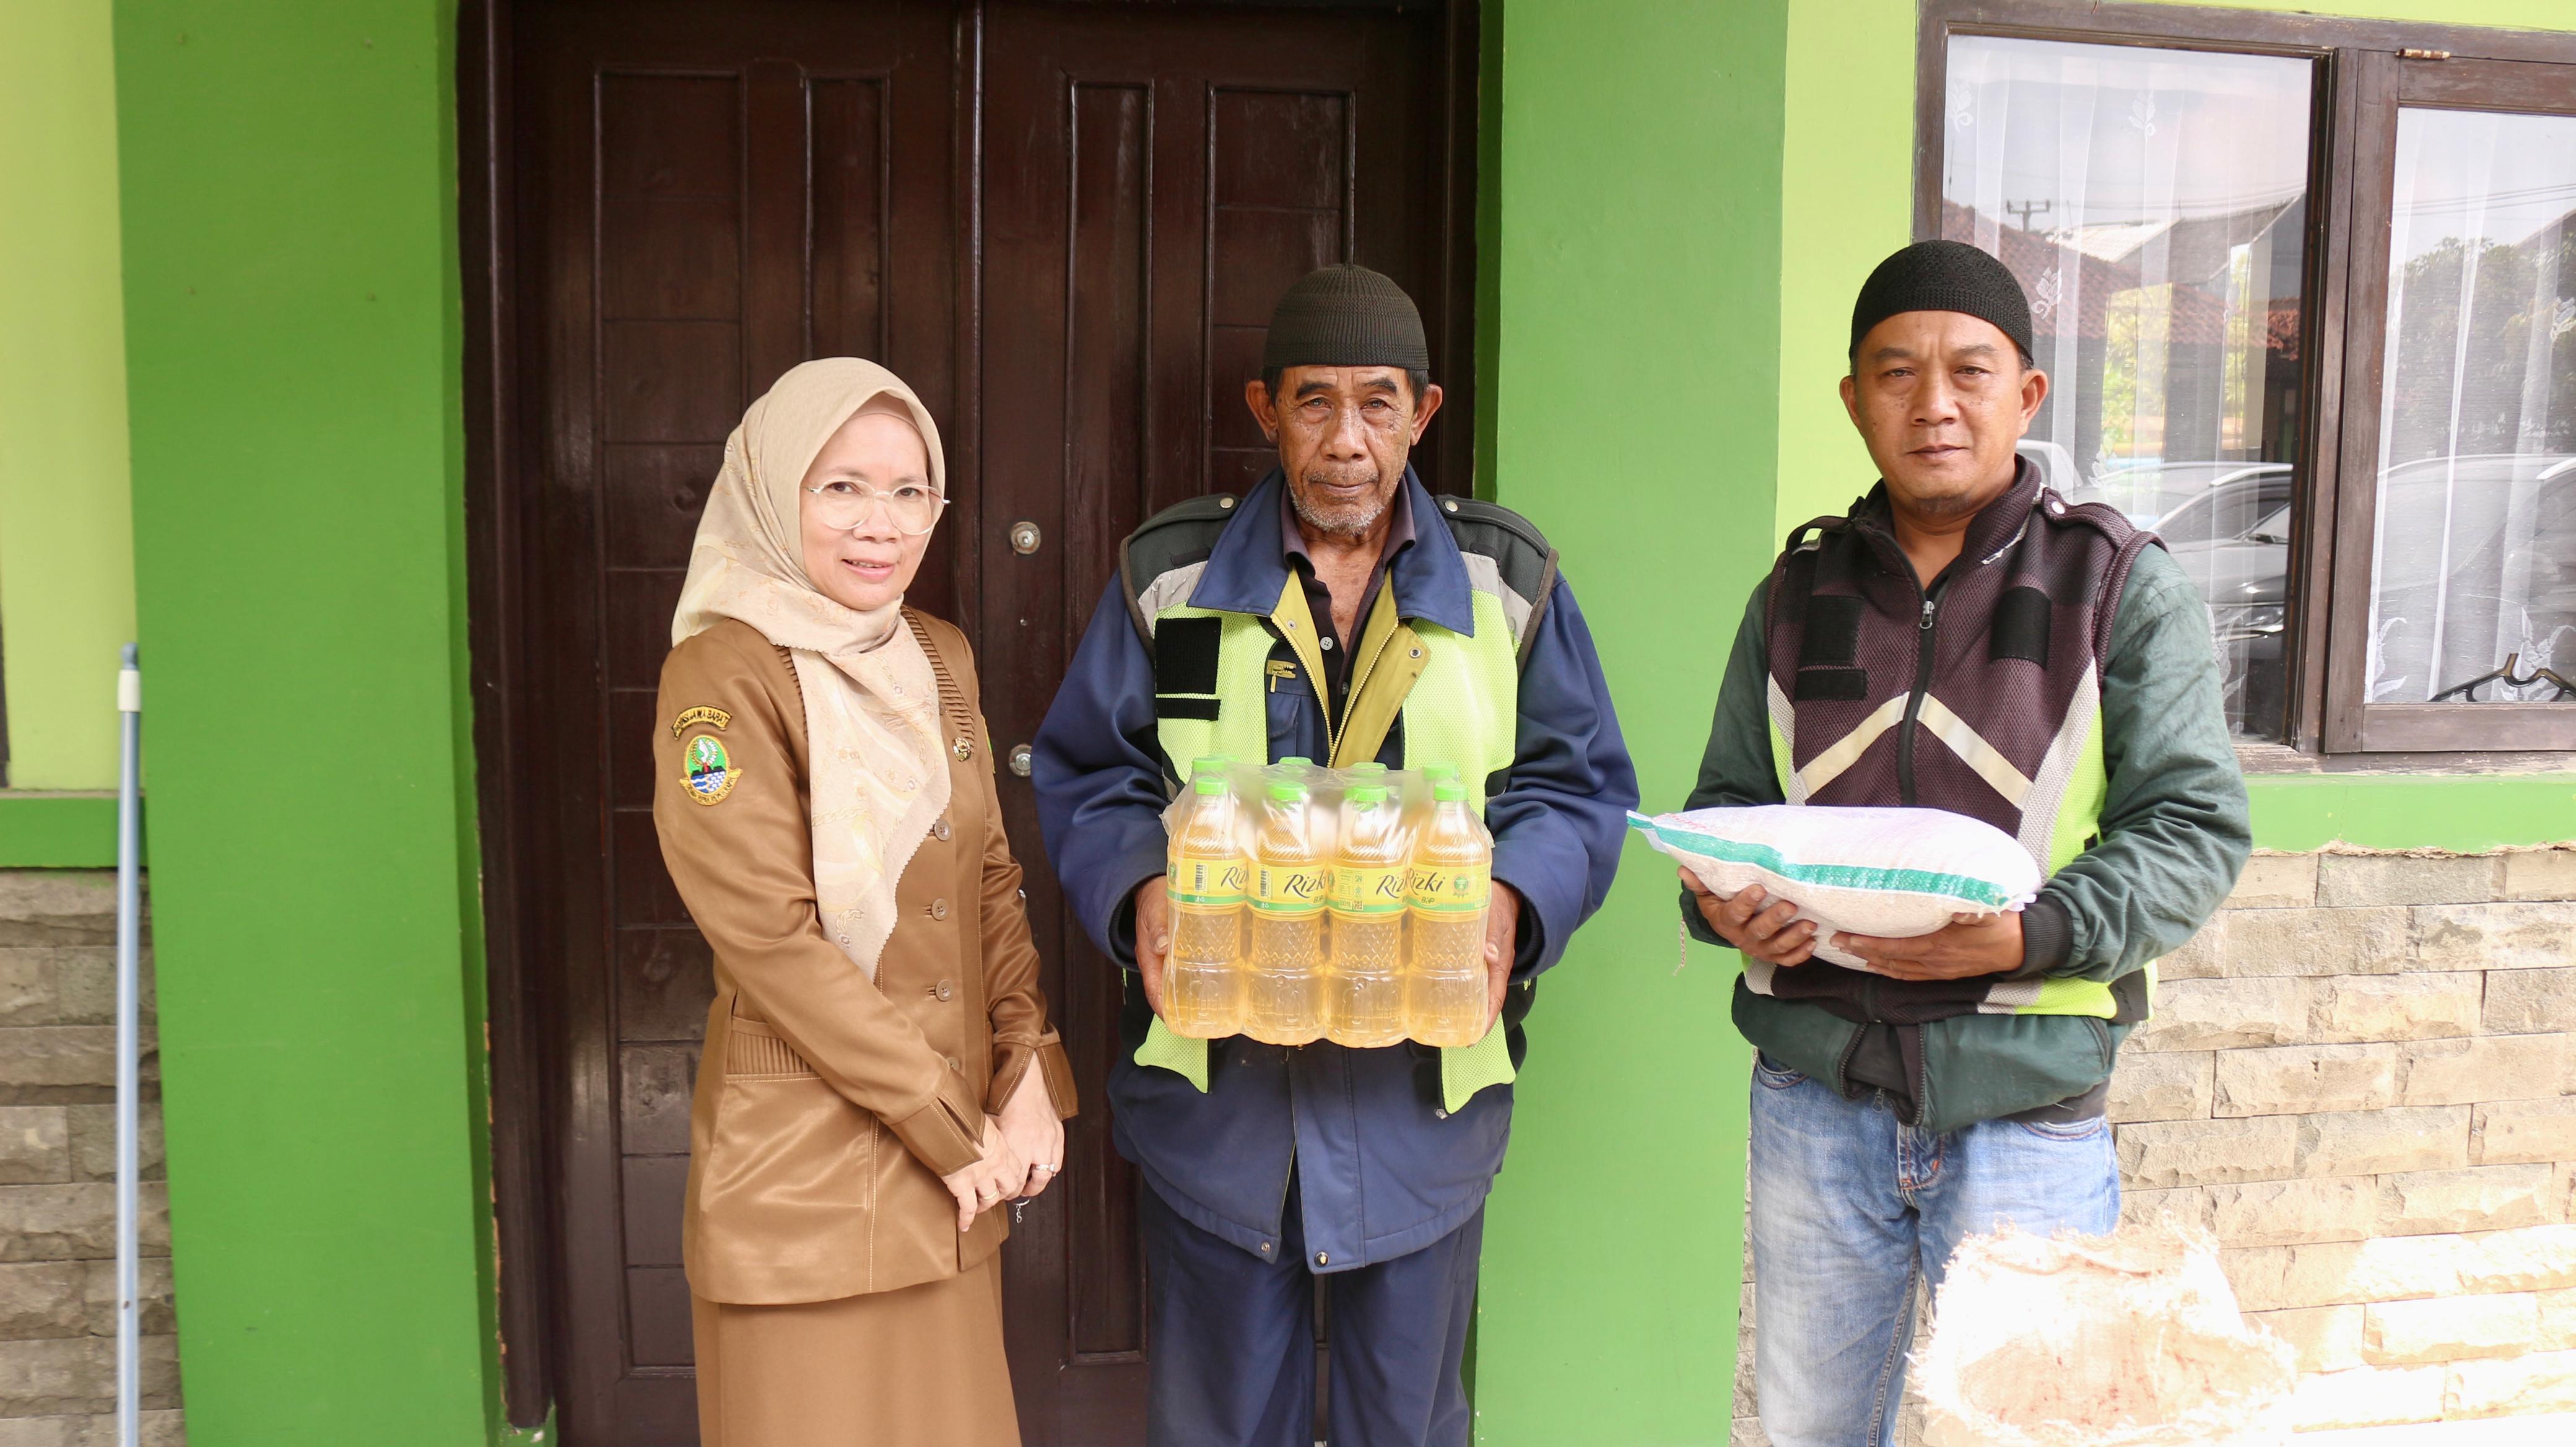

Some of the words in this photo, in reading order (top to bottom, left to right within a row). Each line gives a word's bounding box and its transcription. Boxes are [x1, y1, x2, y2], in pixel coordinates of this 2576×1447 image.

[707, 710, 729, 724] BARAT
[1221, 866, 1248, 891] Riz
[1408, 867, 1445, 896] Rizki
